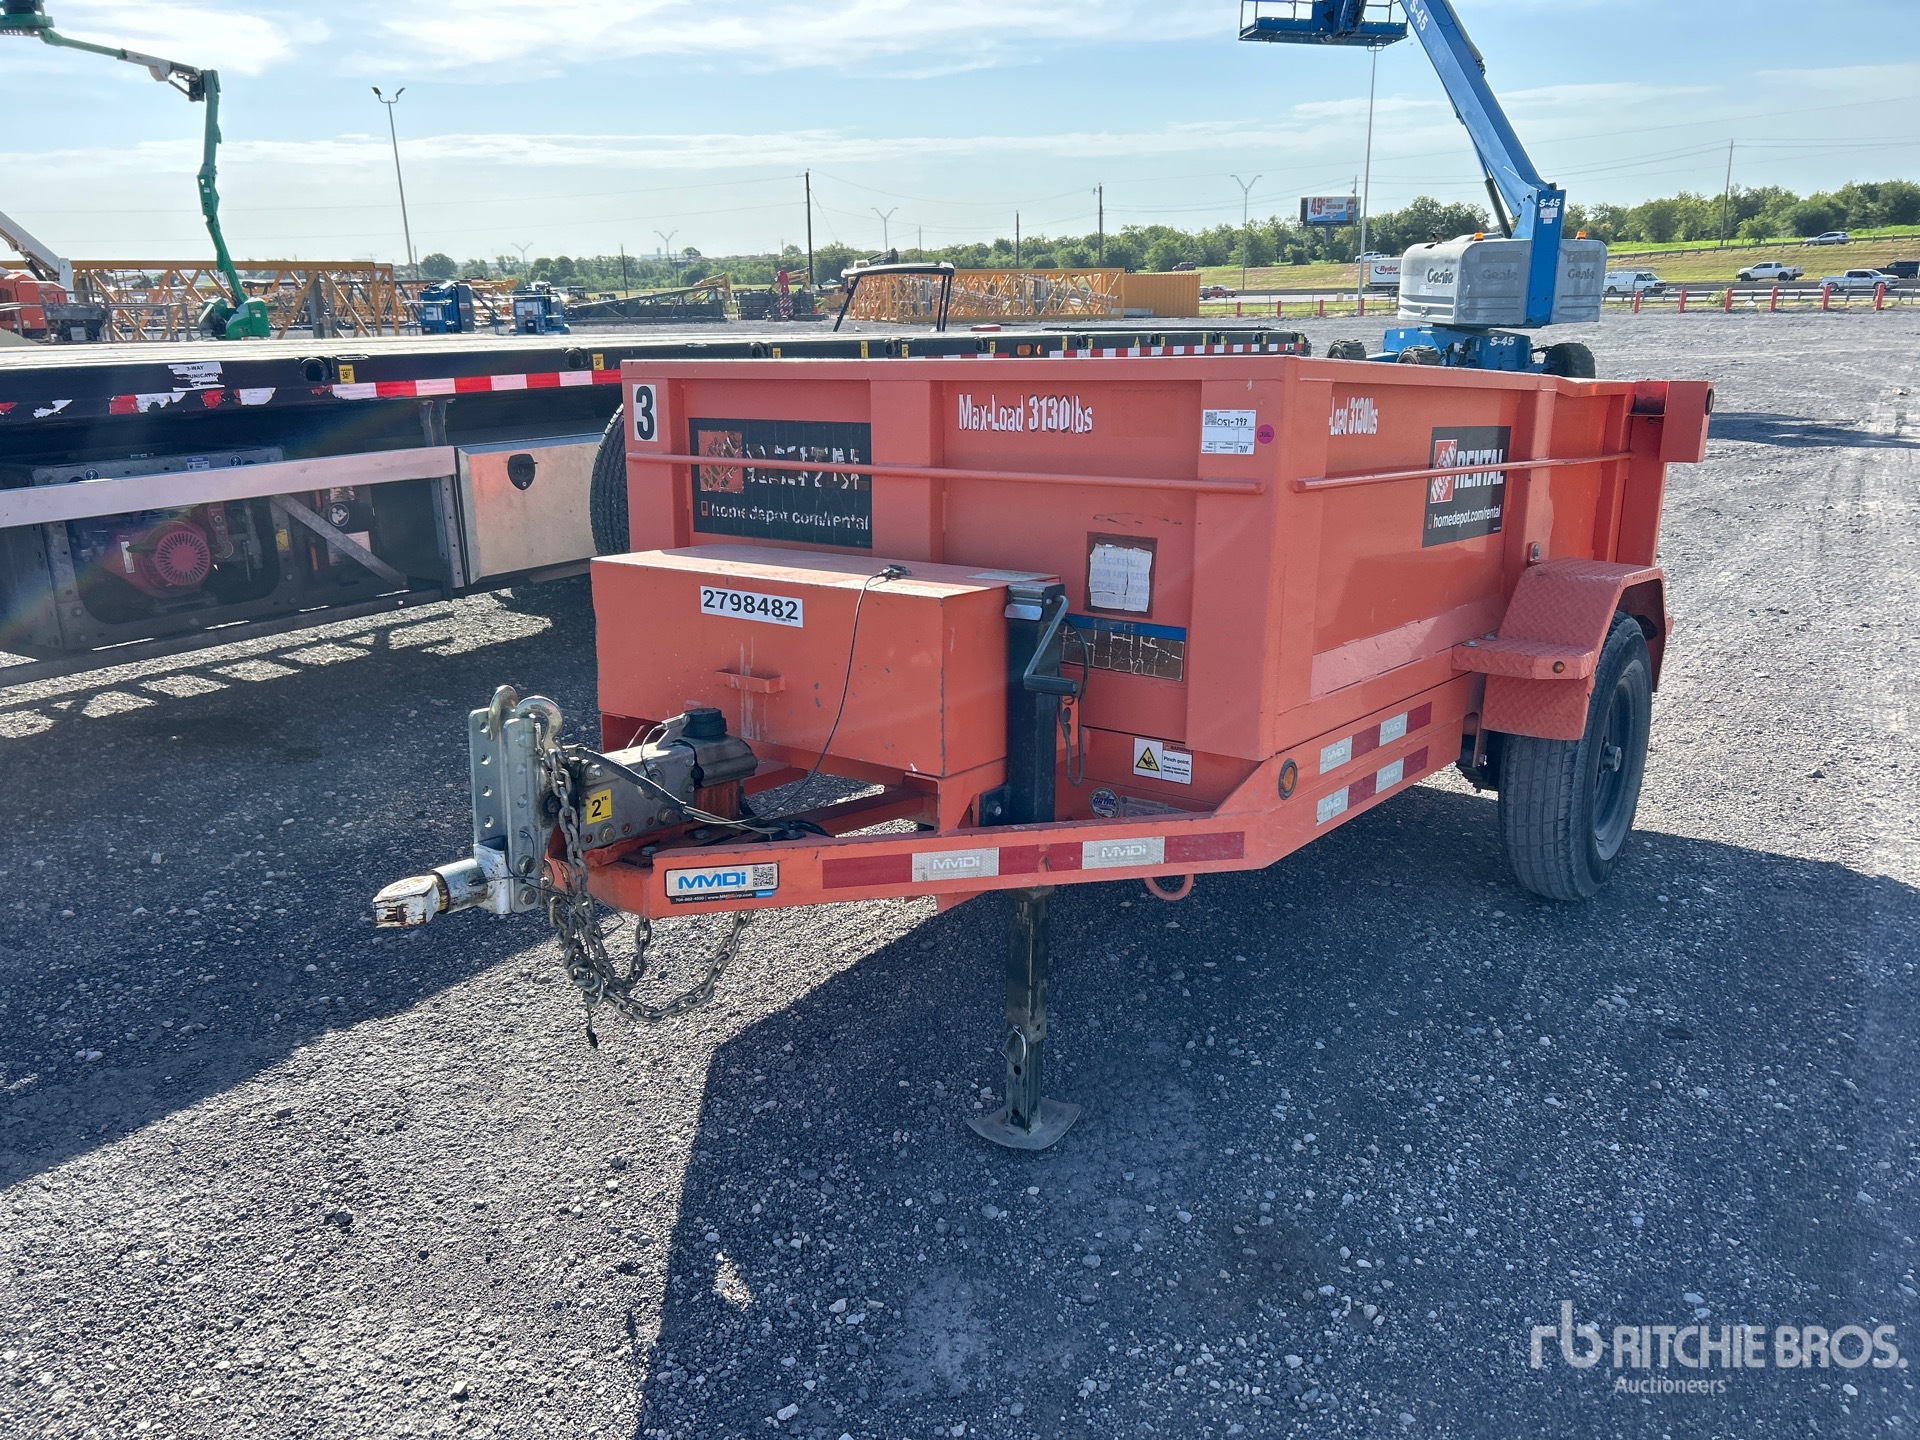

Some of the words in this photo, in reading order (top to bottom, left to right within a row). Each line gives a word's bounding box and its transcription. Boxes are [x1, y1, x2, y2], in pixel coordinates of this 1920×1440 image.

[1410, 0, 1429, 32] S-45
[1539, 199, 1560, 207] S-45
[1379, 265, 1398, 274] Ryder
[1427, 267, 1454, 285] Genie
[1481, 268, 1518, 281] Genie
[1567, 268, 1596, 281] Genie
[1489, 335, 1516, 347] S-45
[635, 385, 655, 441] 3
[958, 393, 1025, 432] Max-Load
[1028, 393, 1093, 434] 3130lbs
[1329, 396, 1350, 436] -Load
[1455, 448, 1504, 489] RENTAL
[1433, 504, 1502, 529] homedepot.com/rental
[702, 589, 799, 621] 2798482
[1163, 755, 1177, 763] Pinch
[1102, 845, 1147, 857] MMDi
[933, 856, 980, 869] MMDi
[678, 872, 746, 889] MMDi
